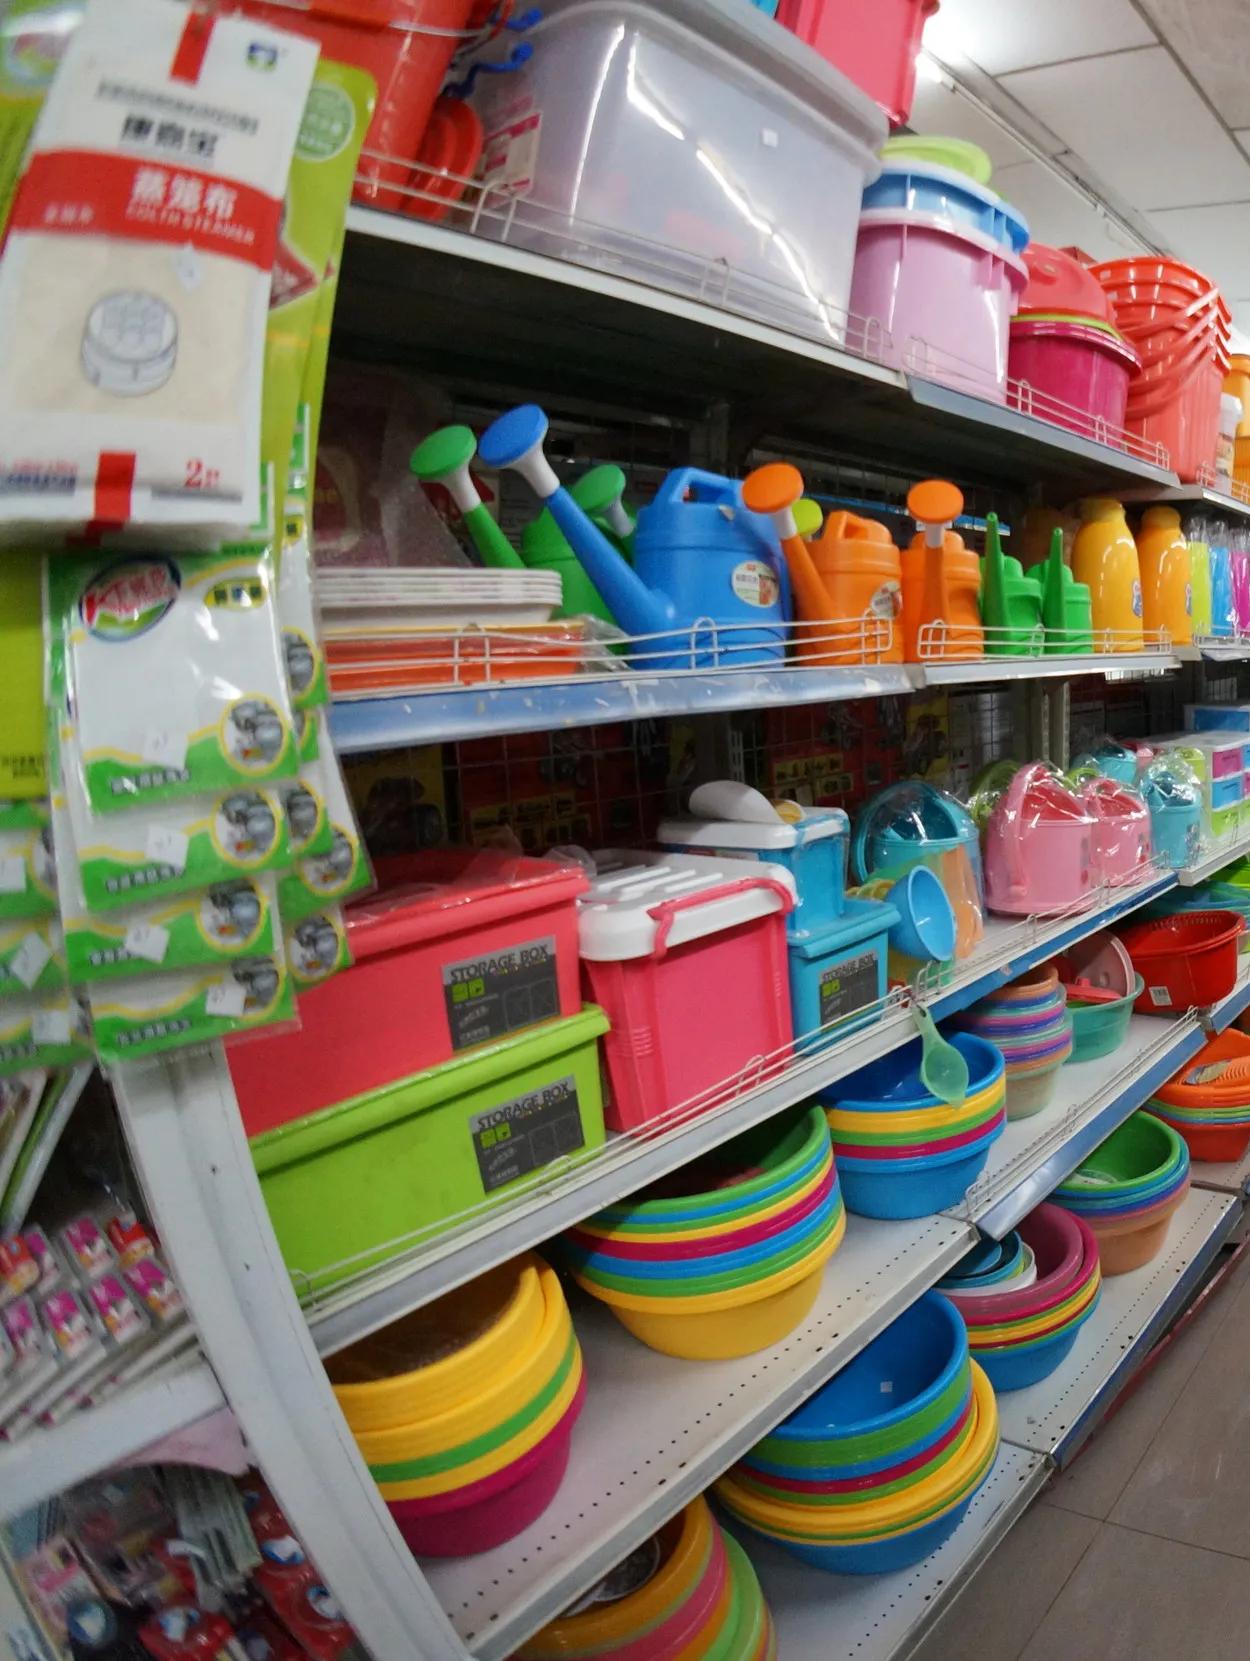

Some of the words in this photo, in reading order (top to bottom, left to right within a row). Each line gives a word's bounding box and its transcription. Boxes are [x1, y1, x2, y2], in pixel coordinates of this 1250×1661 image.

[450, 952, 517, 984] STORAGE
[519, 944, 549, 964] BOX
[822, 959, 858, 981] STORAGE
[859, 951, 875, 968] BOX
[477, 1093, 541, 1130] STORAGE
[542, 1080, 570, 1101] BOX
